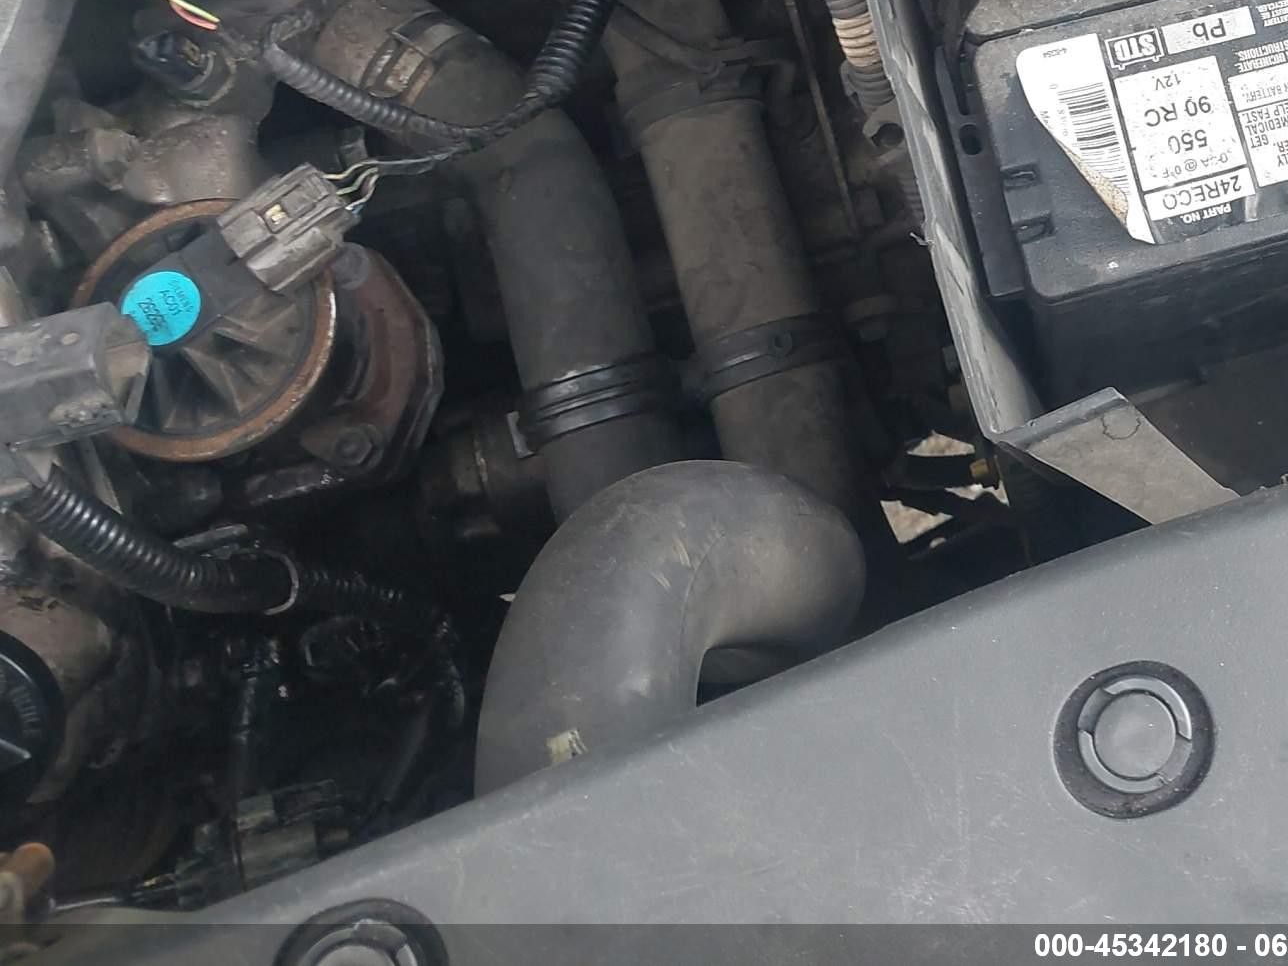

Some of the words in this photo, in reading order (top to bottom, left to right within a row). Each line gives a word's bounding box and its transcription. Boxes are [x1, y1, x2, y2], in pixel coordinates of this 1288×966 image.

[1191, 19, 1225, 40] Pb
[1113, 34, 1155, 60] STD
[1153, 73, 1180, 89] 12V
[1242, 85, 1281, 102] BATTERY.
[1184, 95, 1211, 116] 90
[1143, 104, 1177, 126] RC
[1242, 108, 1269, 122] FAST.
[1244, 116, 1288, 134] MEDICAL
[1166, 129, 1208, 152] 550
[1248, 134, 1268, 147] GET
[1183, 158, 1197, 172] @
[1180, 212, 1200, 223] NO.
[1201, 203, 1230, 217] PART
